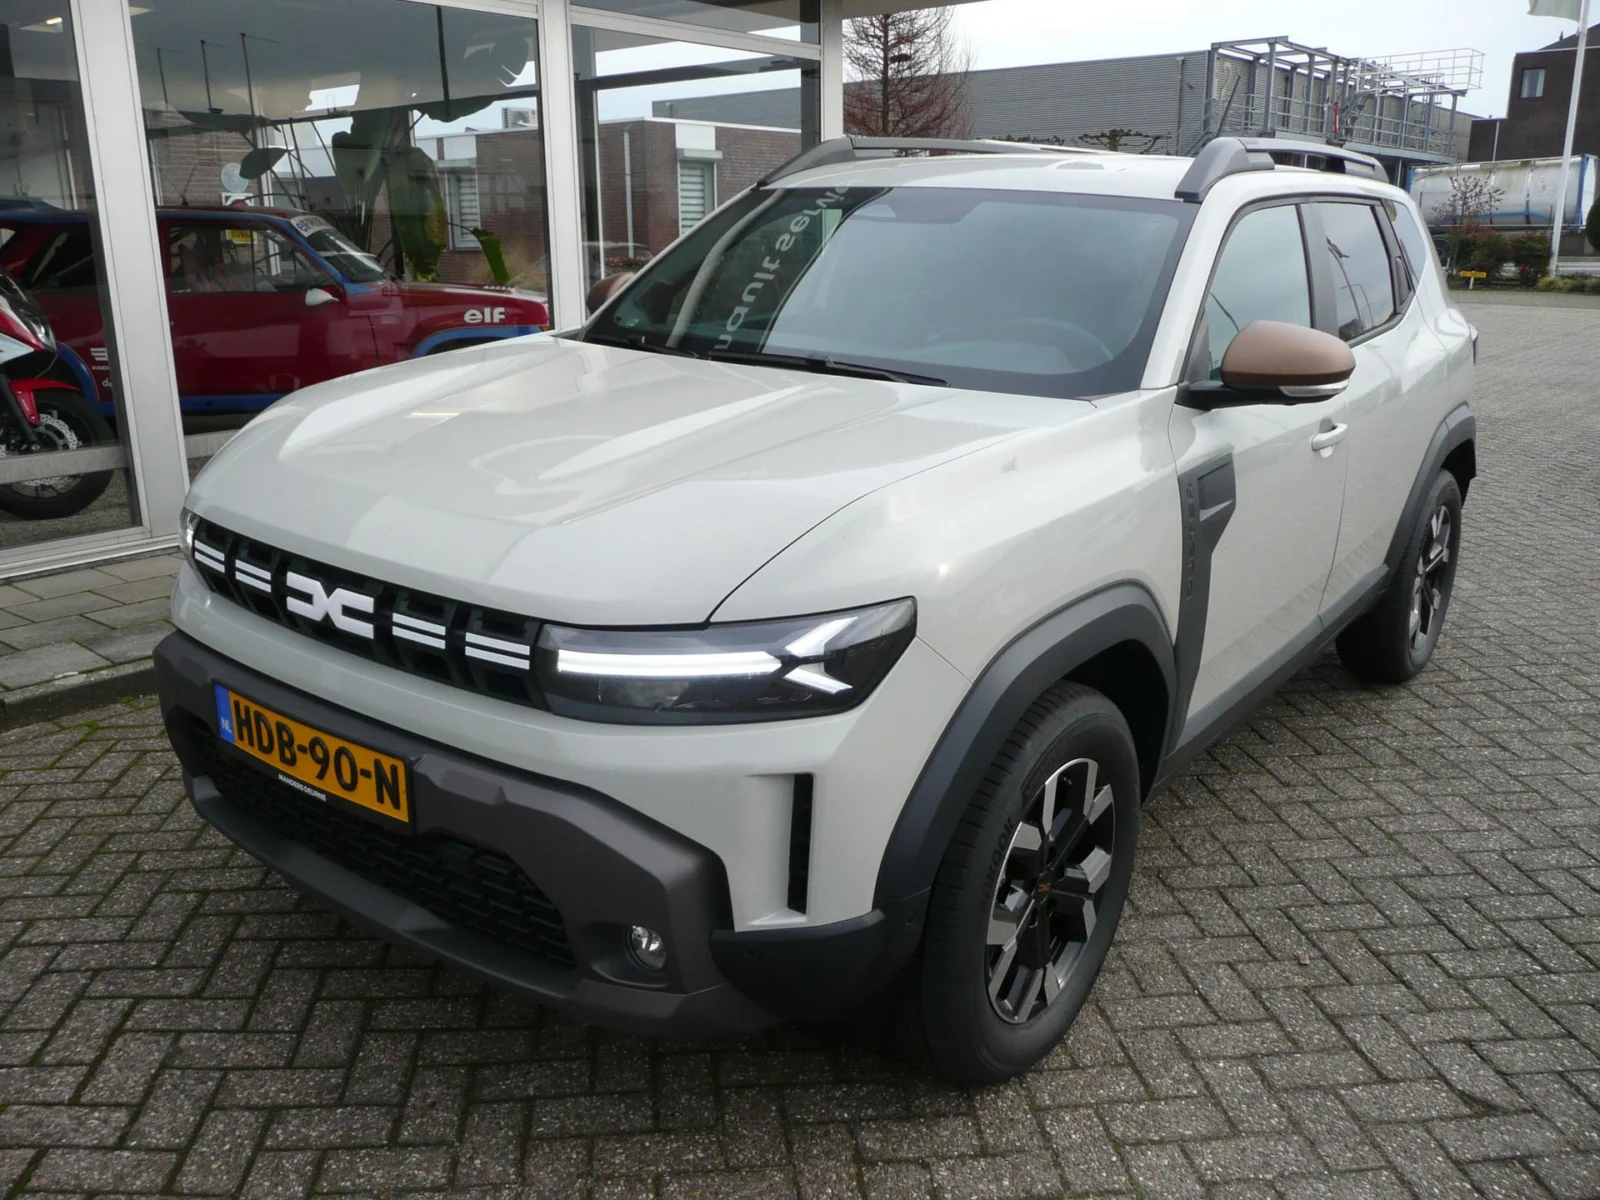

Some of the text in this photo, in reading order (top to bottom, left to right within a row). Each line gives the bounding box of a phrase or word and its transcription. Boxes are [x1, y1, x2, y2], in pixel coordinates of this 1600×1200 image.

[463, 306, 506, 324] elf
[220, 716, 233, 734] NL
[234, 699, 401, 811] HDB-90-N
[278, 772, 327, 802] MANDERS DEURNE
